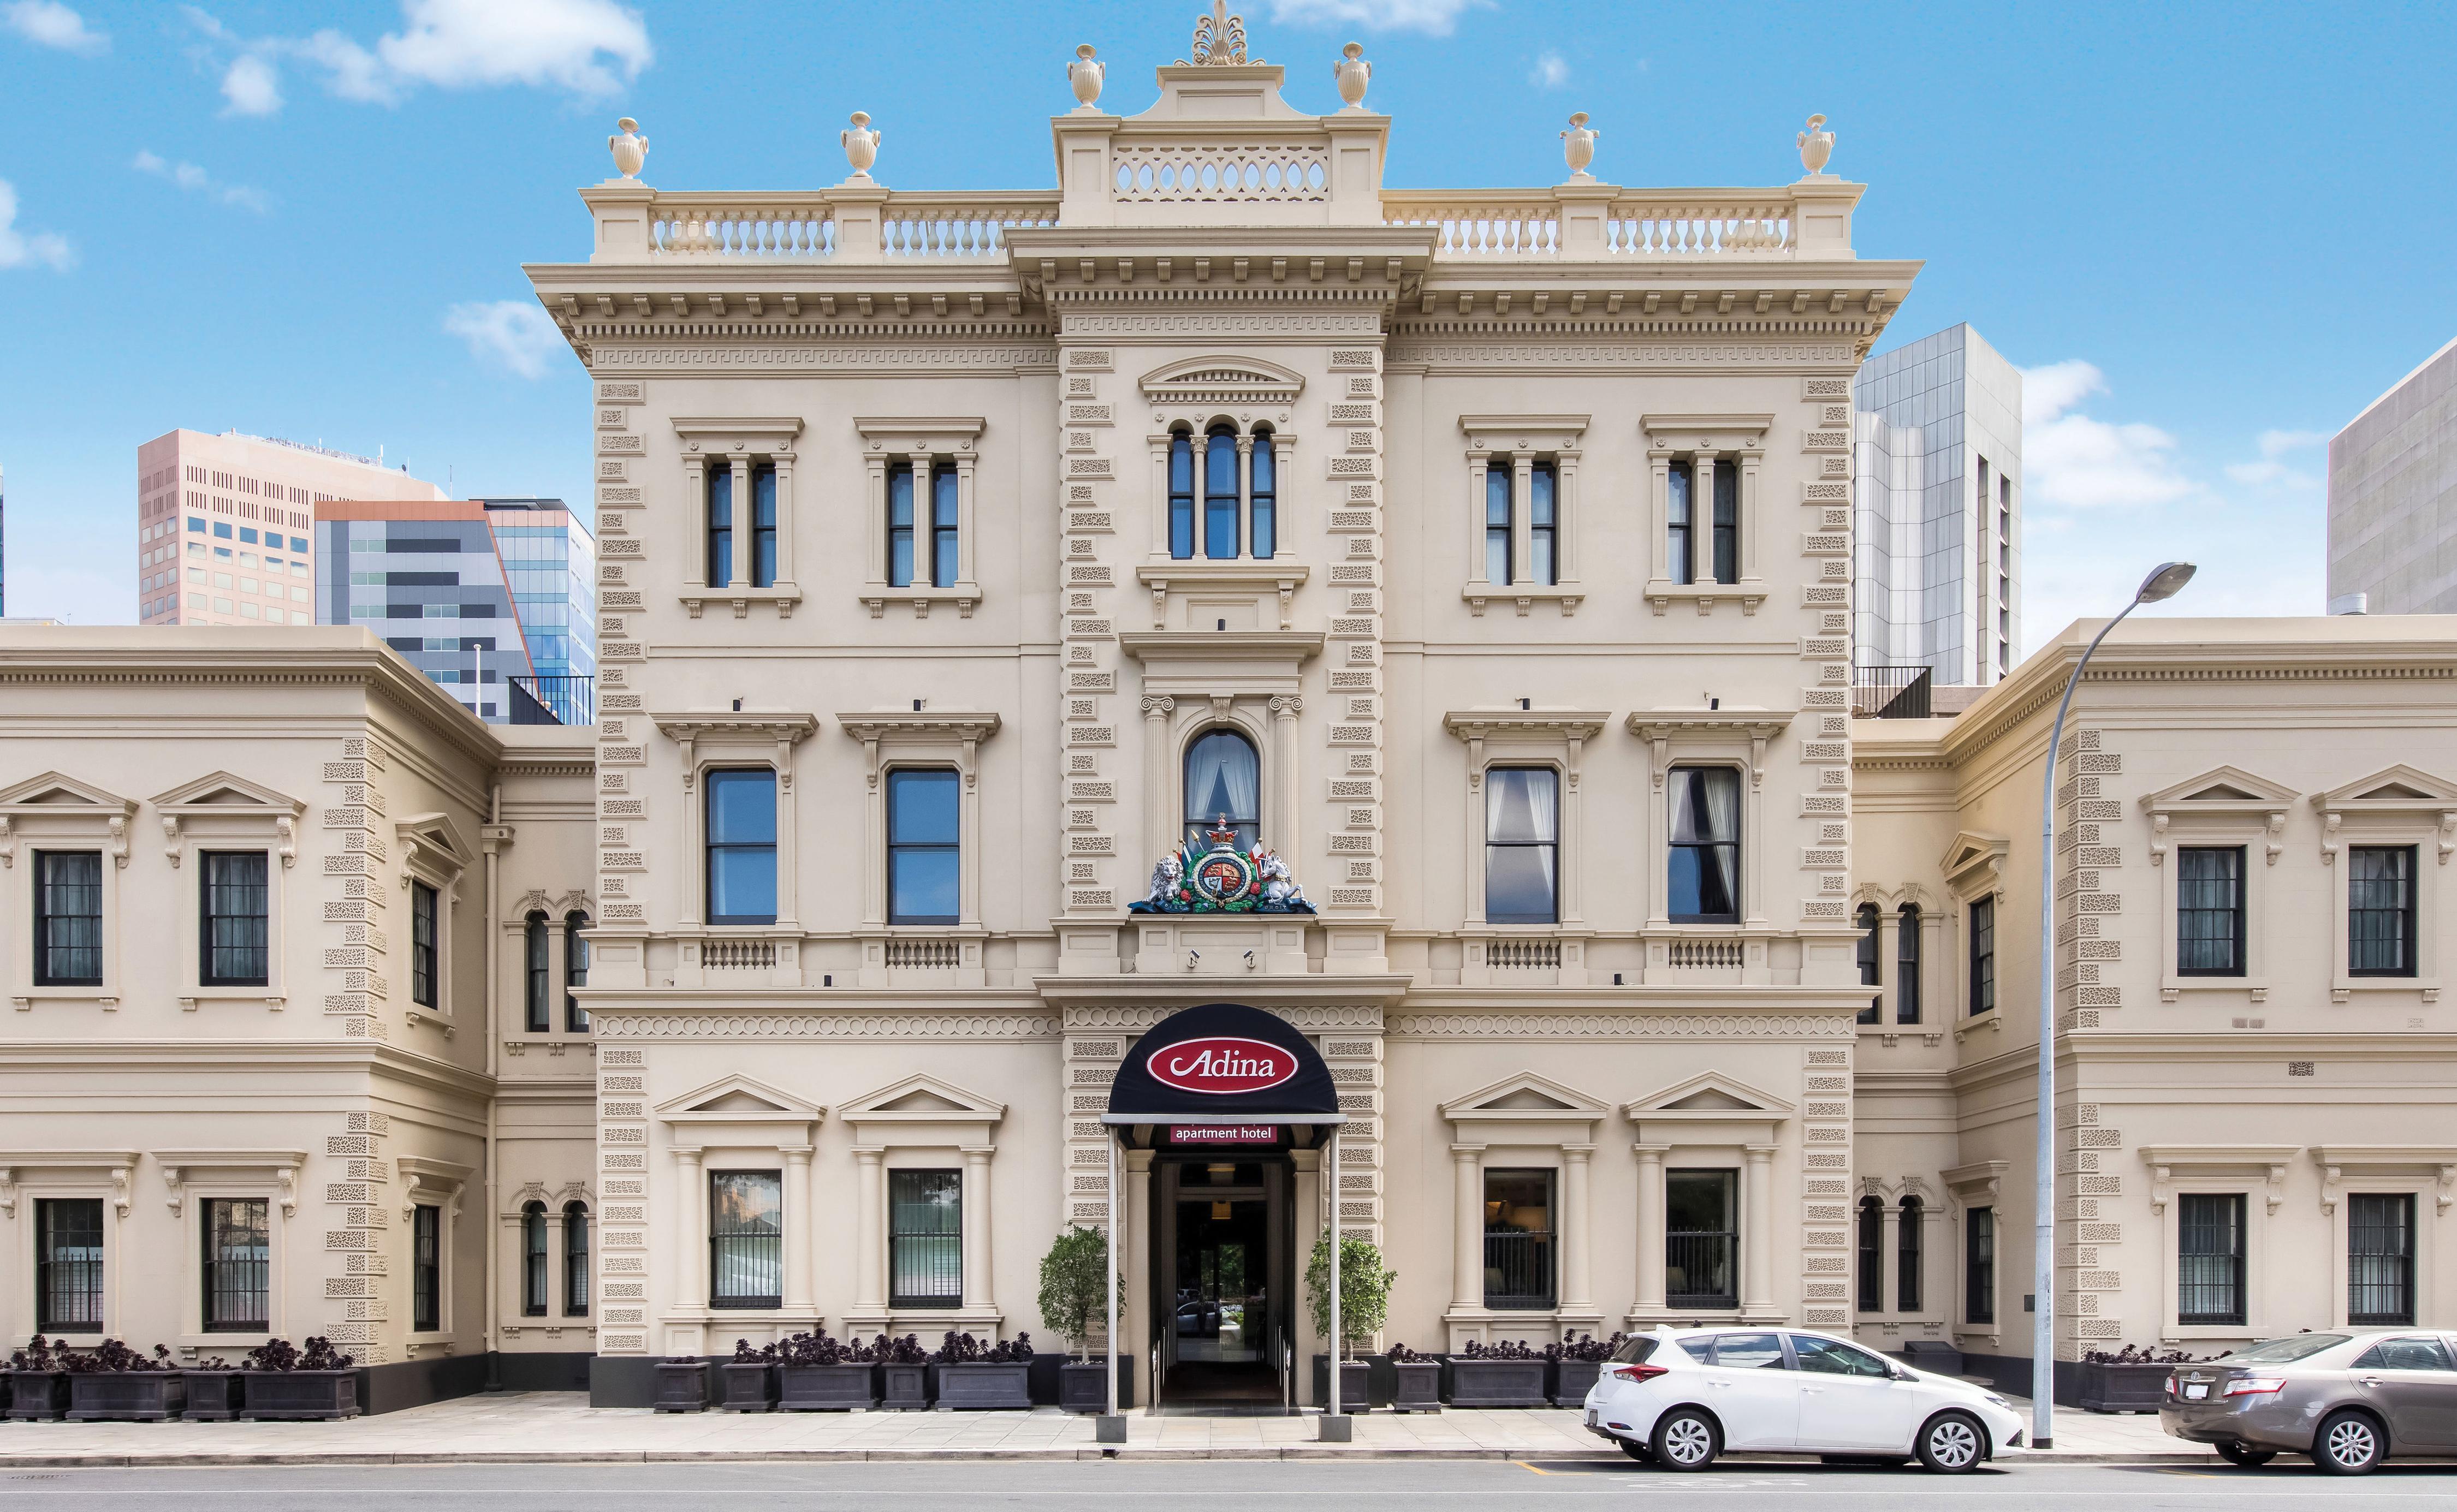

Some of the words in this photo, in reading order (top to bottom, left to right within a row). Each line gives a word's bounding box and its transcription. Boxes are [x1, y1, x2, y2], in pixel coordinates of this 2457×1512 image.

[1170, 1050, 1275, 1077] Adina
[1176, 1128, 1237, 1141] apartment
[1241, 1127, 1271, 1138] hotel
